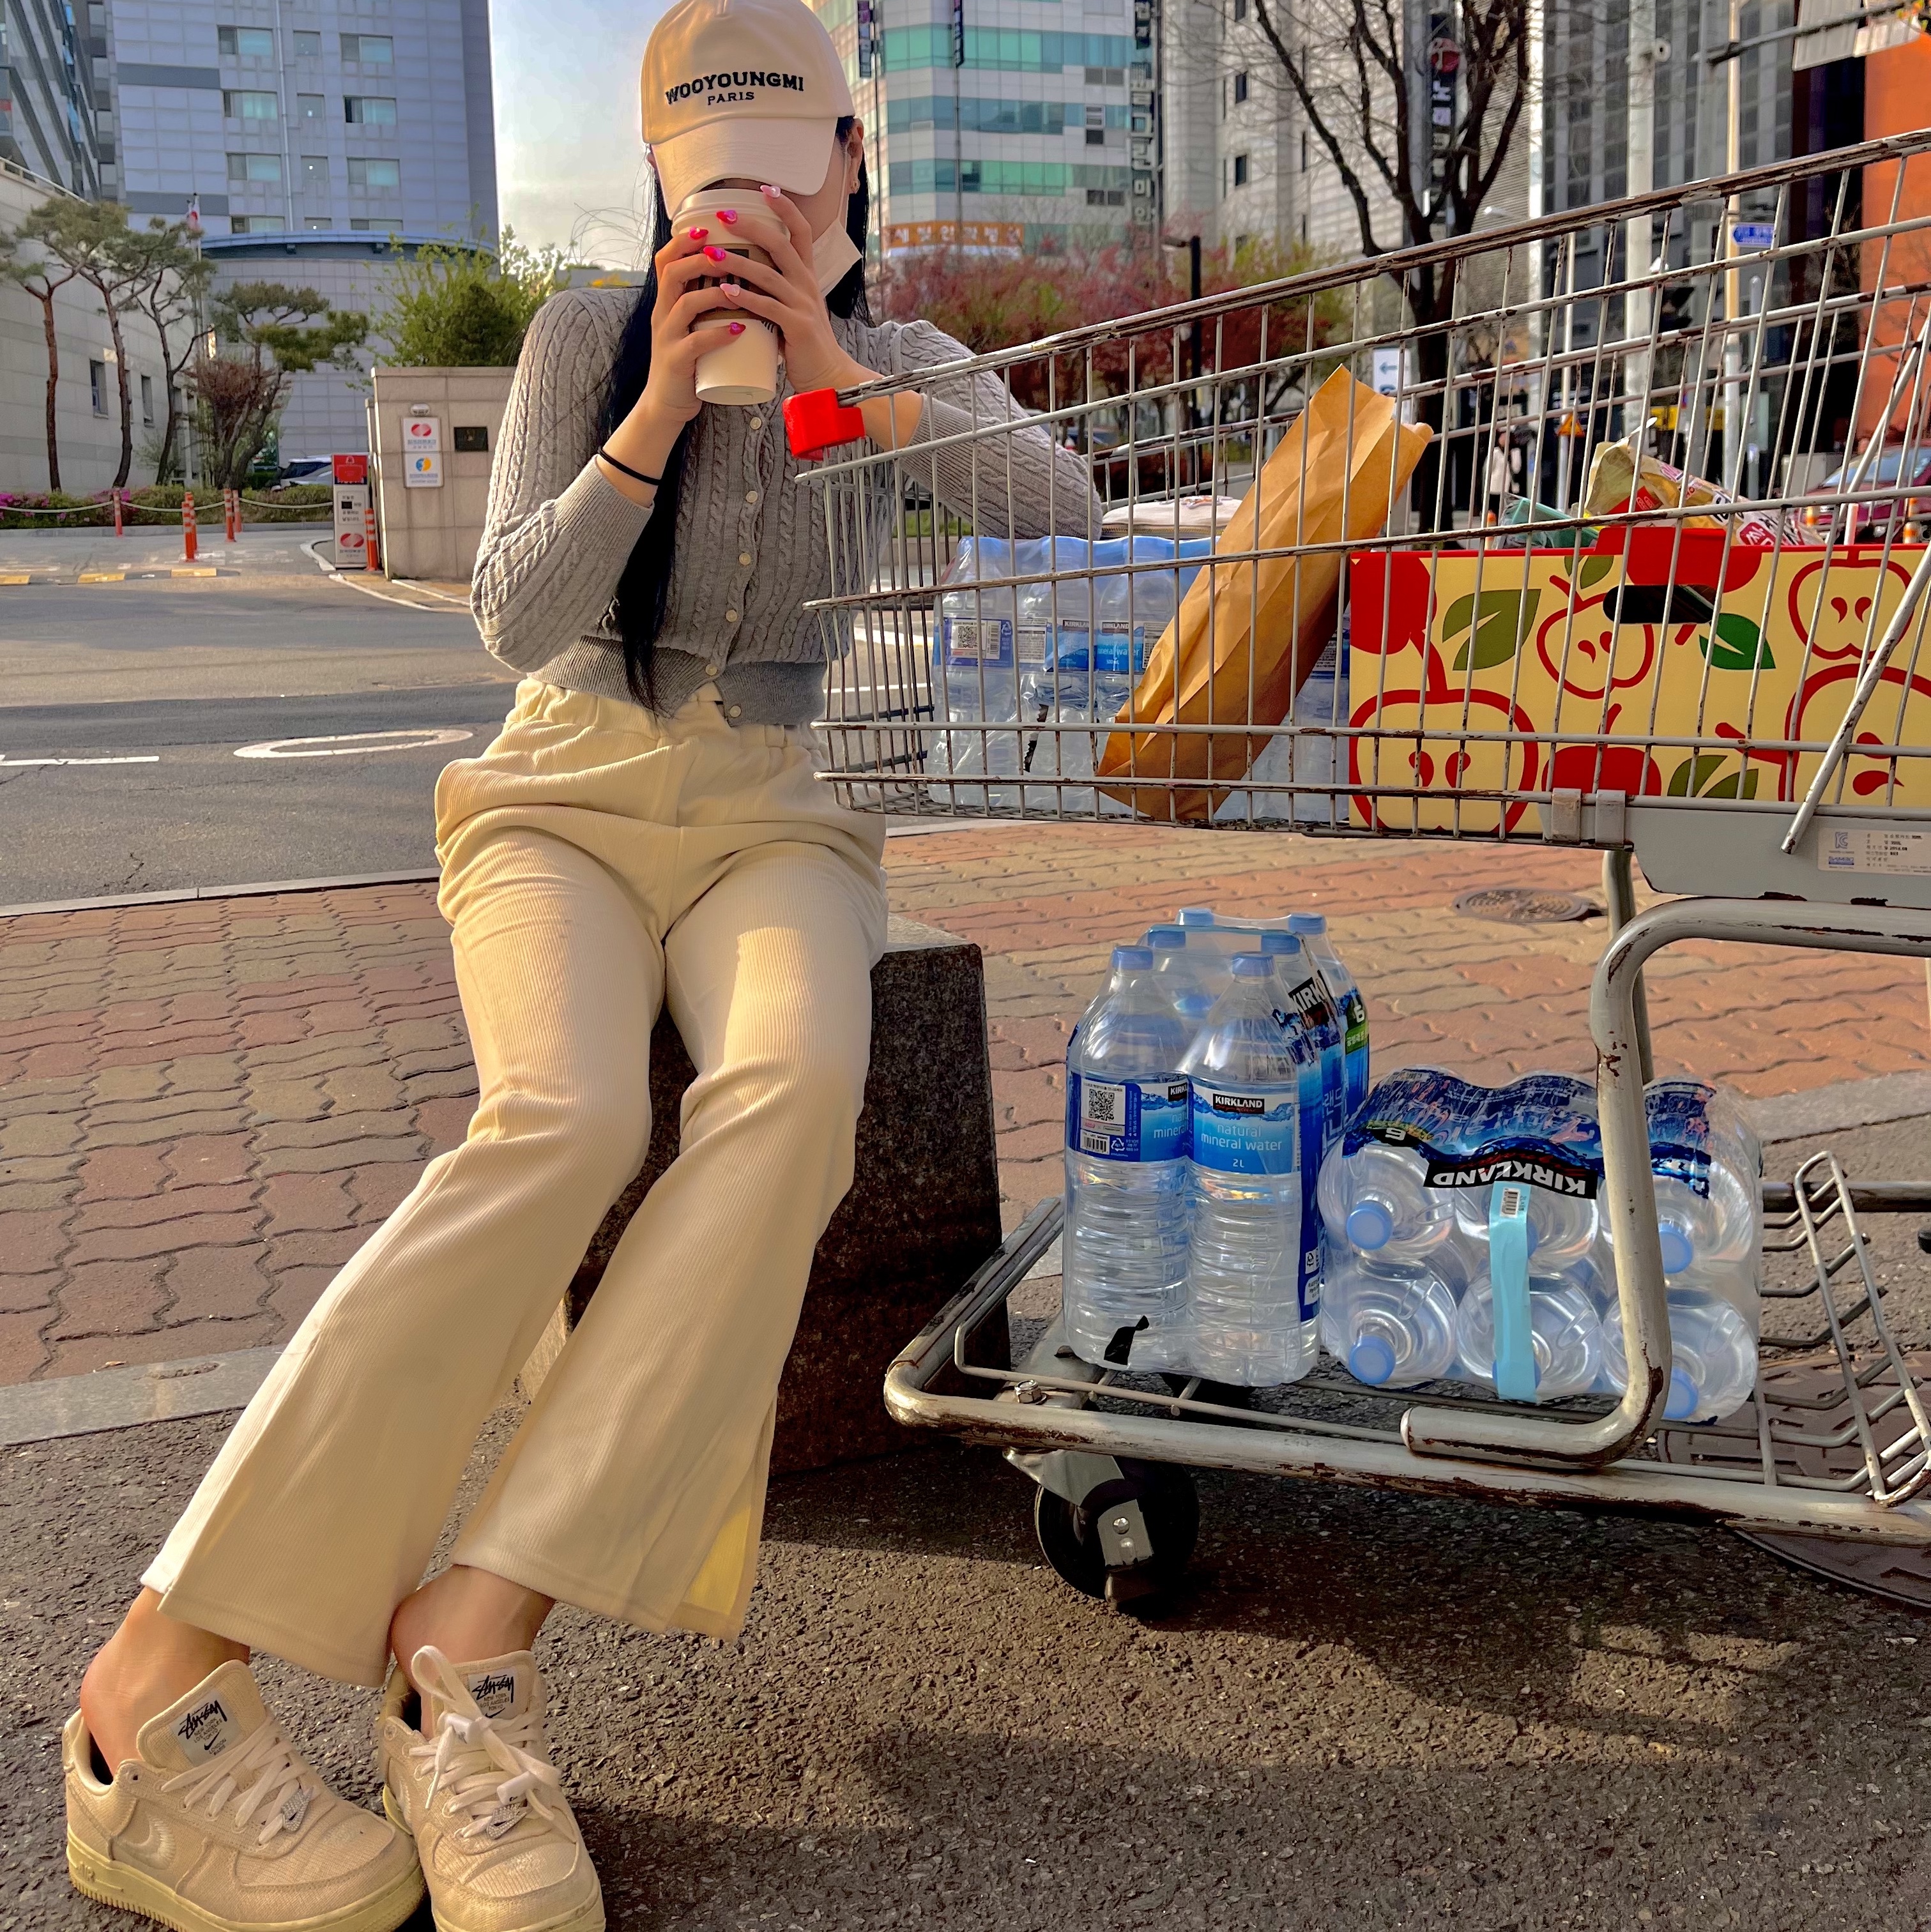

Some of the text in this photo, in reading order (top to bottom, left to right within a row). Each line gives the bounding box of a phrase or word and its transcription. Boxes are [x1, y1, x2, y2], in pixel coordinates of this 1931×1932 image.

[665, 71, 804, 105] WOOYOUNGMI
[707, 91, 755, 105] PARIS
[1215, 1095, 1263, 1108] KIRKLAND
[1217, 1124, 1262, 1137] natural
[1201, 1133, 1282, 1151] mineral water
[1232, 1159, 1244, 1168] 2L
[1433, 1160, 1587, 1195] KIRKLAND
